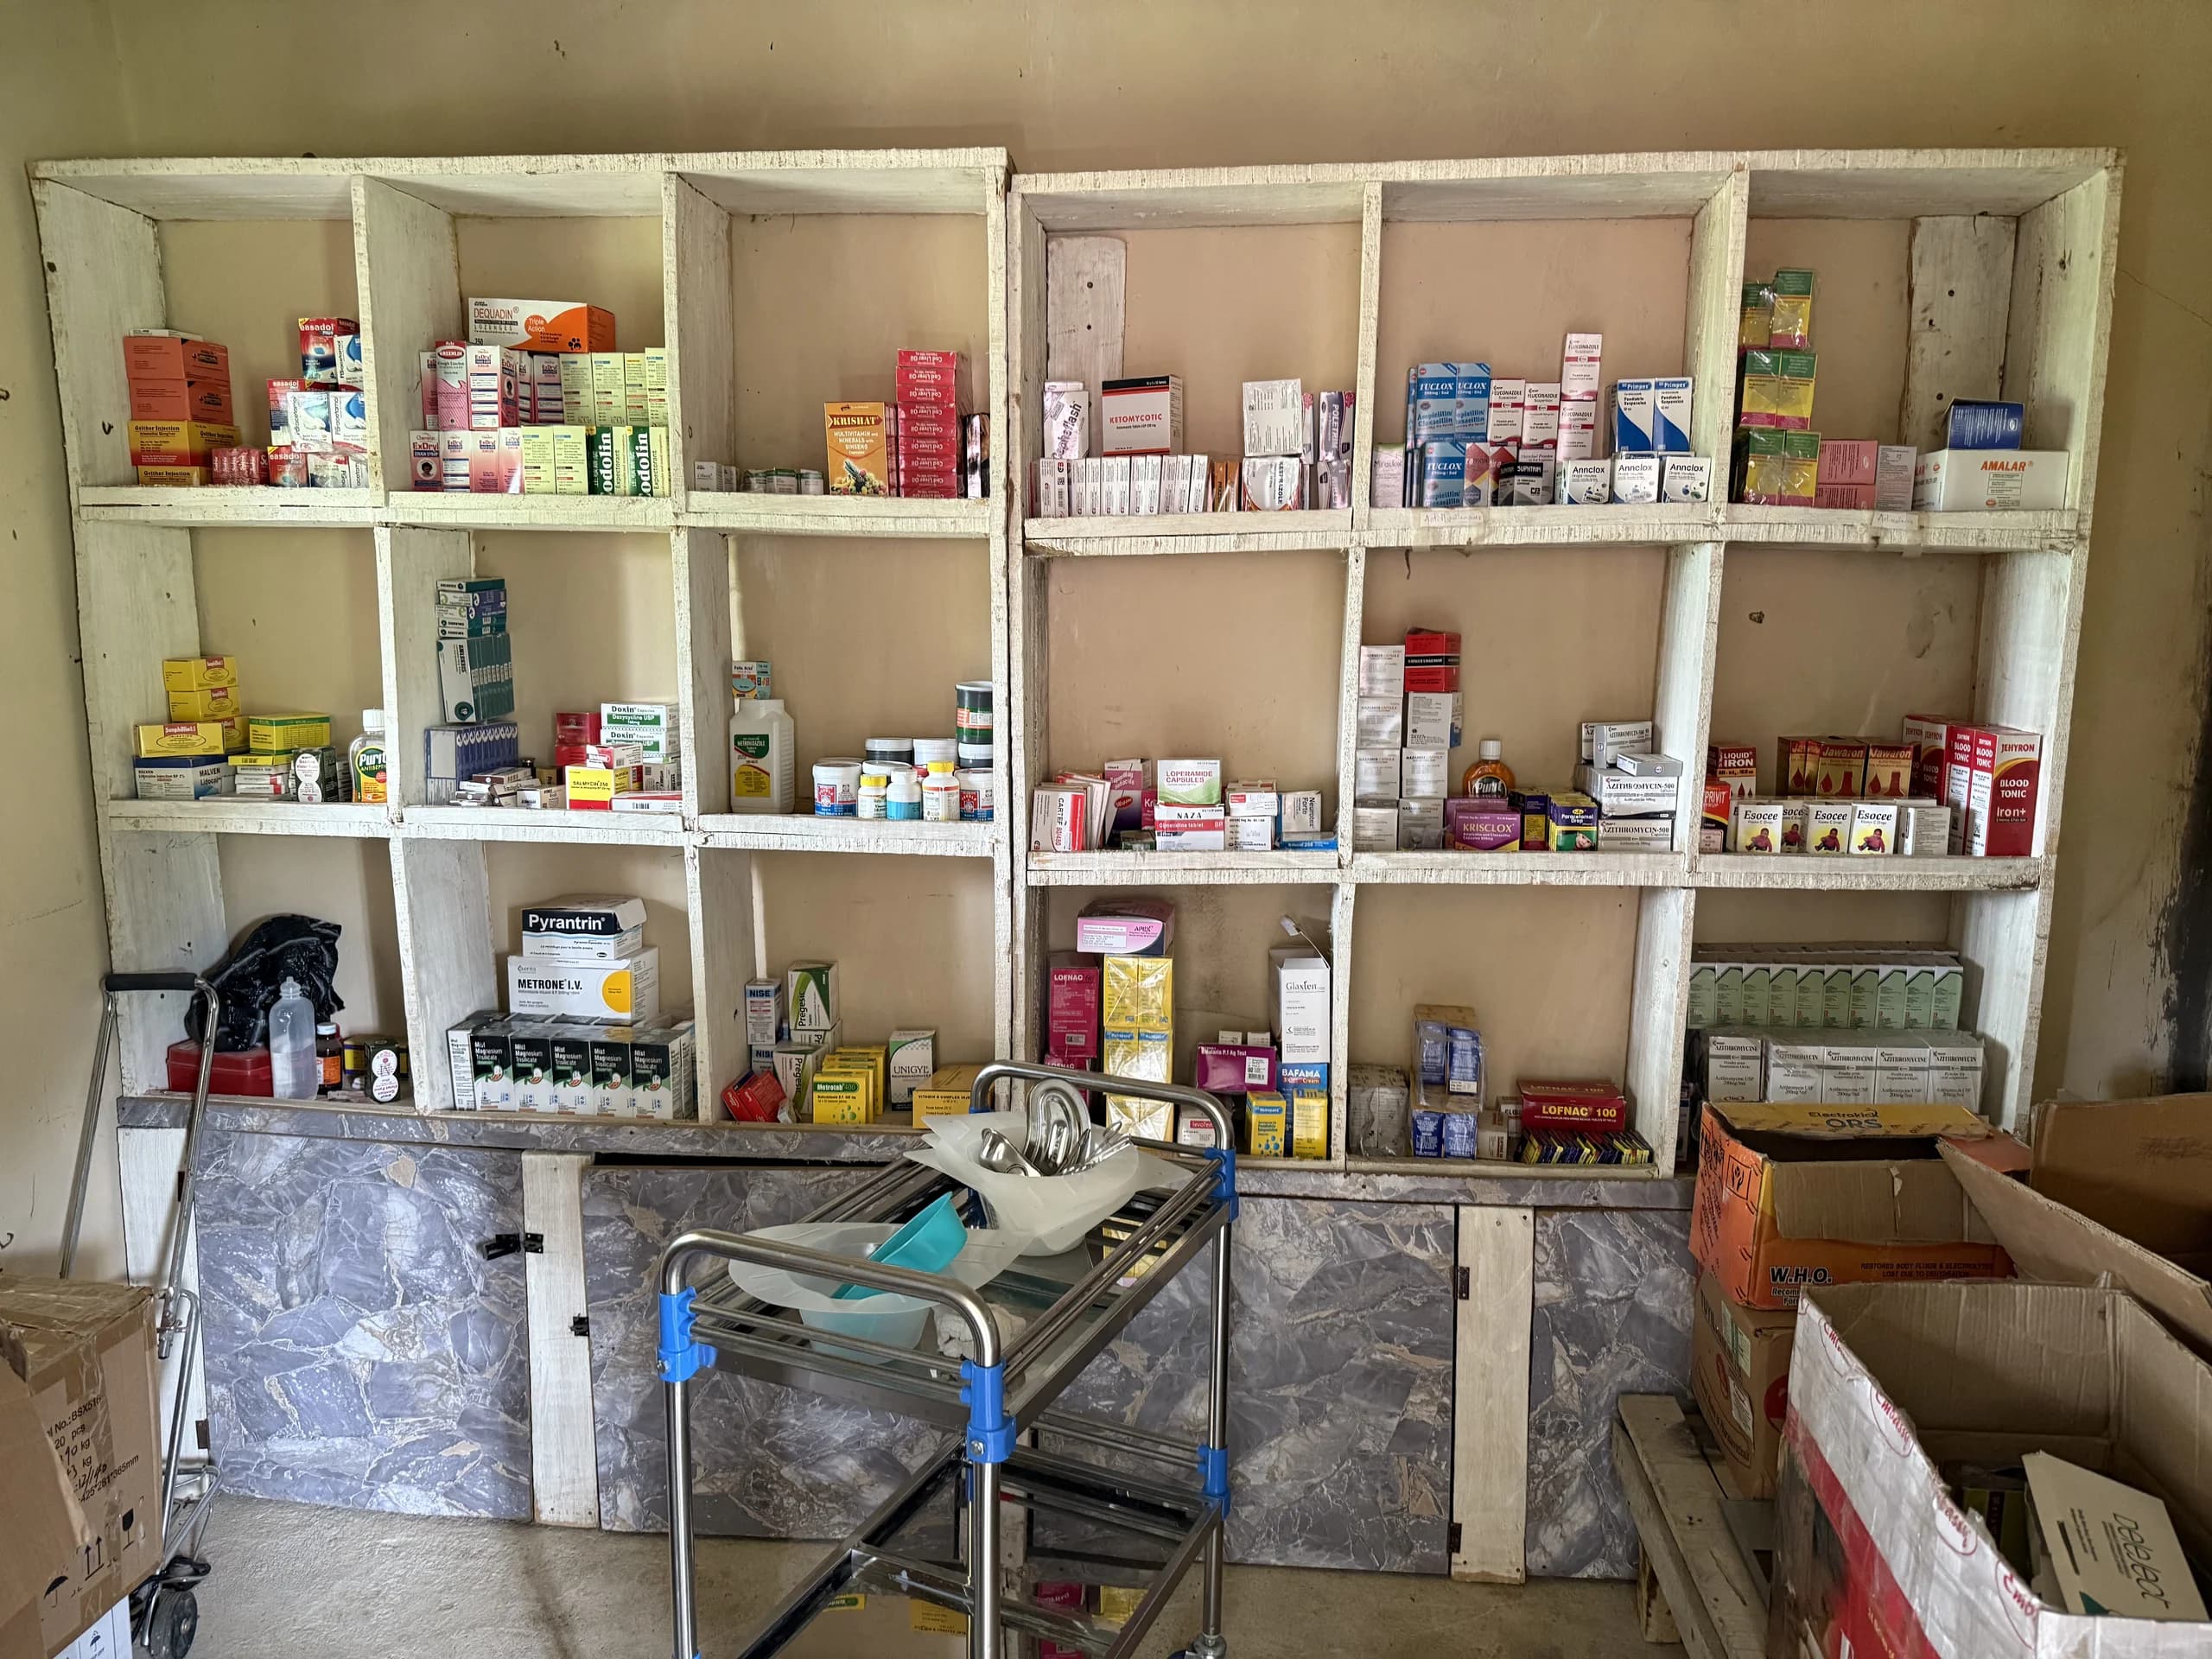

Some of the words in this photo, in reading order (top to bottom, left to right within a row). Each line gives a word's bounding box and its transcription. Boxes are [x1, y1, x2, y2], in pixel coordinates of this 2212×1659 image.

[474, 308, 513, 319] DEQUADIN
[833, 416, 877, 427] KRISHAT
[1109, 413, 1162, 424] KETOMYCOTIC
[413, 442, 439, 451] ExDryl
[1573, 465, 1605, 474] Annclox
[1618, 463, 1653, 472] Annclox
[1669, 463, 1704, 472] Annclox
[1980, 461, 2026, 472] AMALAR
[1954, 741, 1971, 753] BLOOD
[1976, 747, 1993, 758] BLOOD
[2001, 743, 2036, 753] JEHYRON
[1724, 759, 1754, 767] IRON
[1954, 752, 1969, 763] TONIC
[1976, 757, 1992, 768] TONIC
[200, 767, 220, 778] MALVEN
[1999, 779, 2030, 788] BLOOD
[2000, 790, 2026, 798] TONIC
[1744, 810, 1778, 821] Esocee
[1815, 810, 1847, 821] Esocee
[1858, 810, 1892, 821] Esocee
[1997, 806, 2026, 818] Iron+
[1463, 823, 1512, 833] KRISCLOX
[529, 914, 602, 931] Pyrantrin
[518, 978, 564, 990] METRONE
[568, 980, 582, 990] I.V.
[749, 989, 771, 998] NISE
[798, 991, 806, 1027] Pregesic
[893, 1065, 927, 1074] UNIGYL
[1281, 1068, 1321, 1077] BAFAMA
[794, 1058, 803, 1094] Pregesic
[1541, 1105, 1588, 1116] LOFNAC
[1596, 1109, 1617, 1117] 100
[1808, 1109, 1879, 1119] Electrokick
[1826, 1117, 1883, 1129] ORS
[1770, 1266, 1832, 1284] W.H.O.
[54, 1437, 67, 1449] 20
[71, 1424, 86, 1440] pcs
[79, 1438, 91, 1452] kg
[82, 1455, 92, 1468] kg
